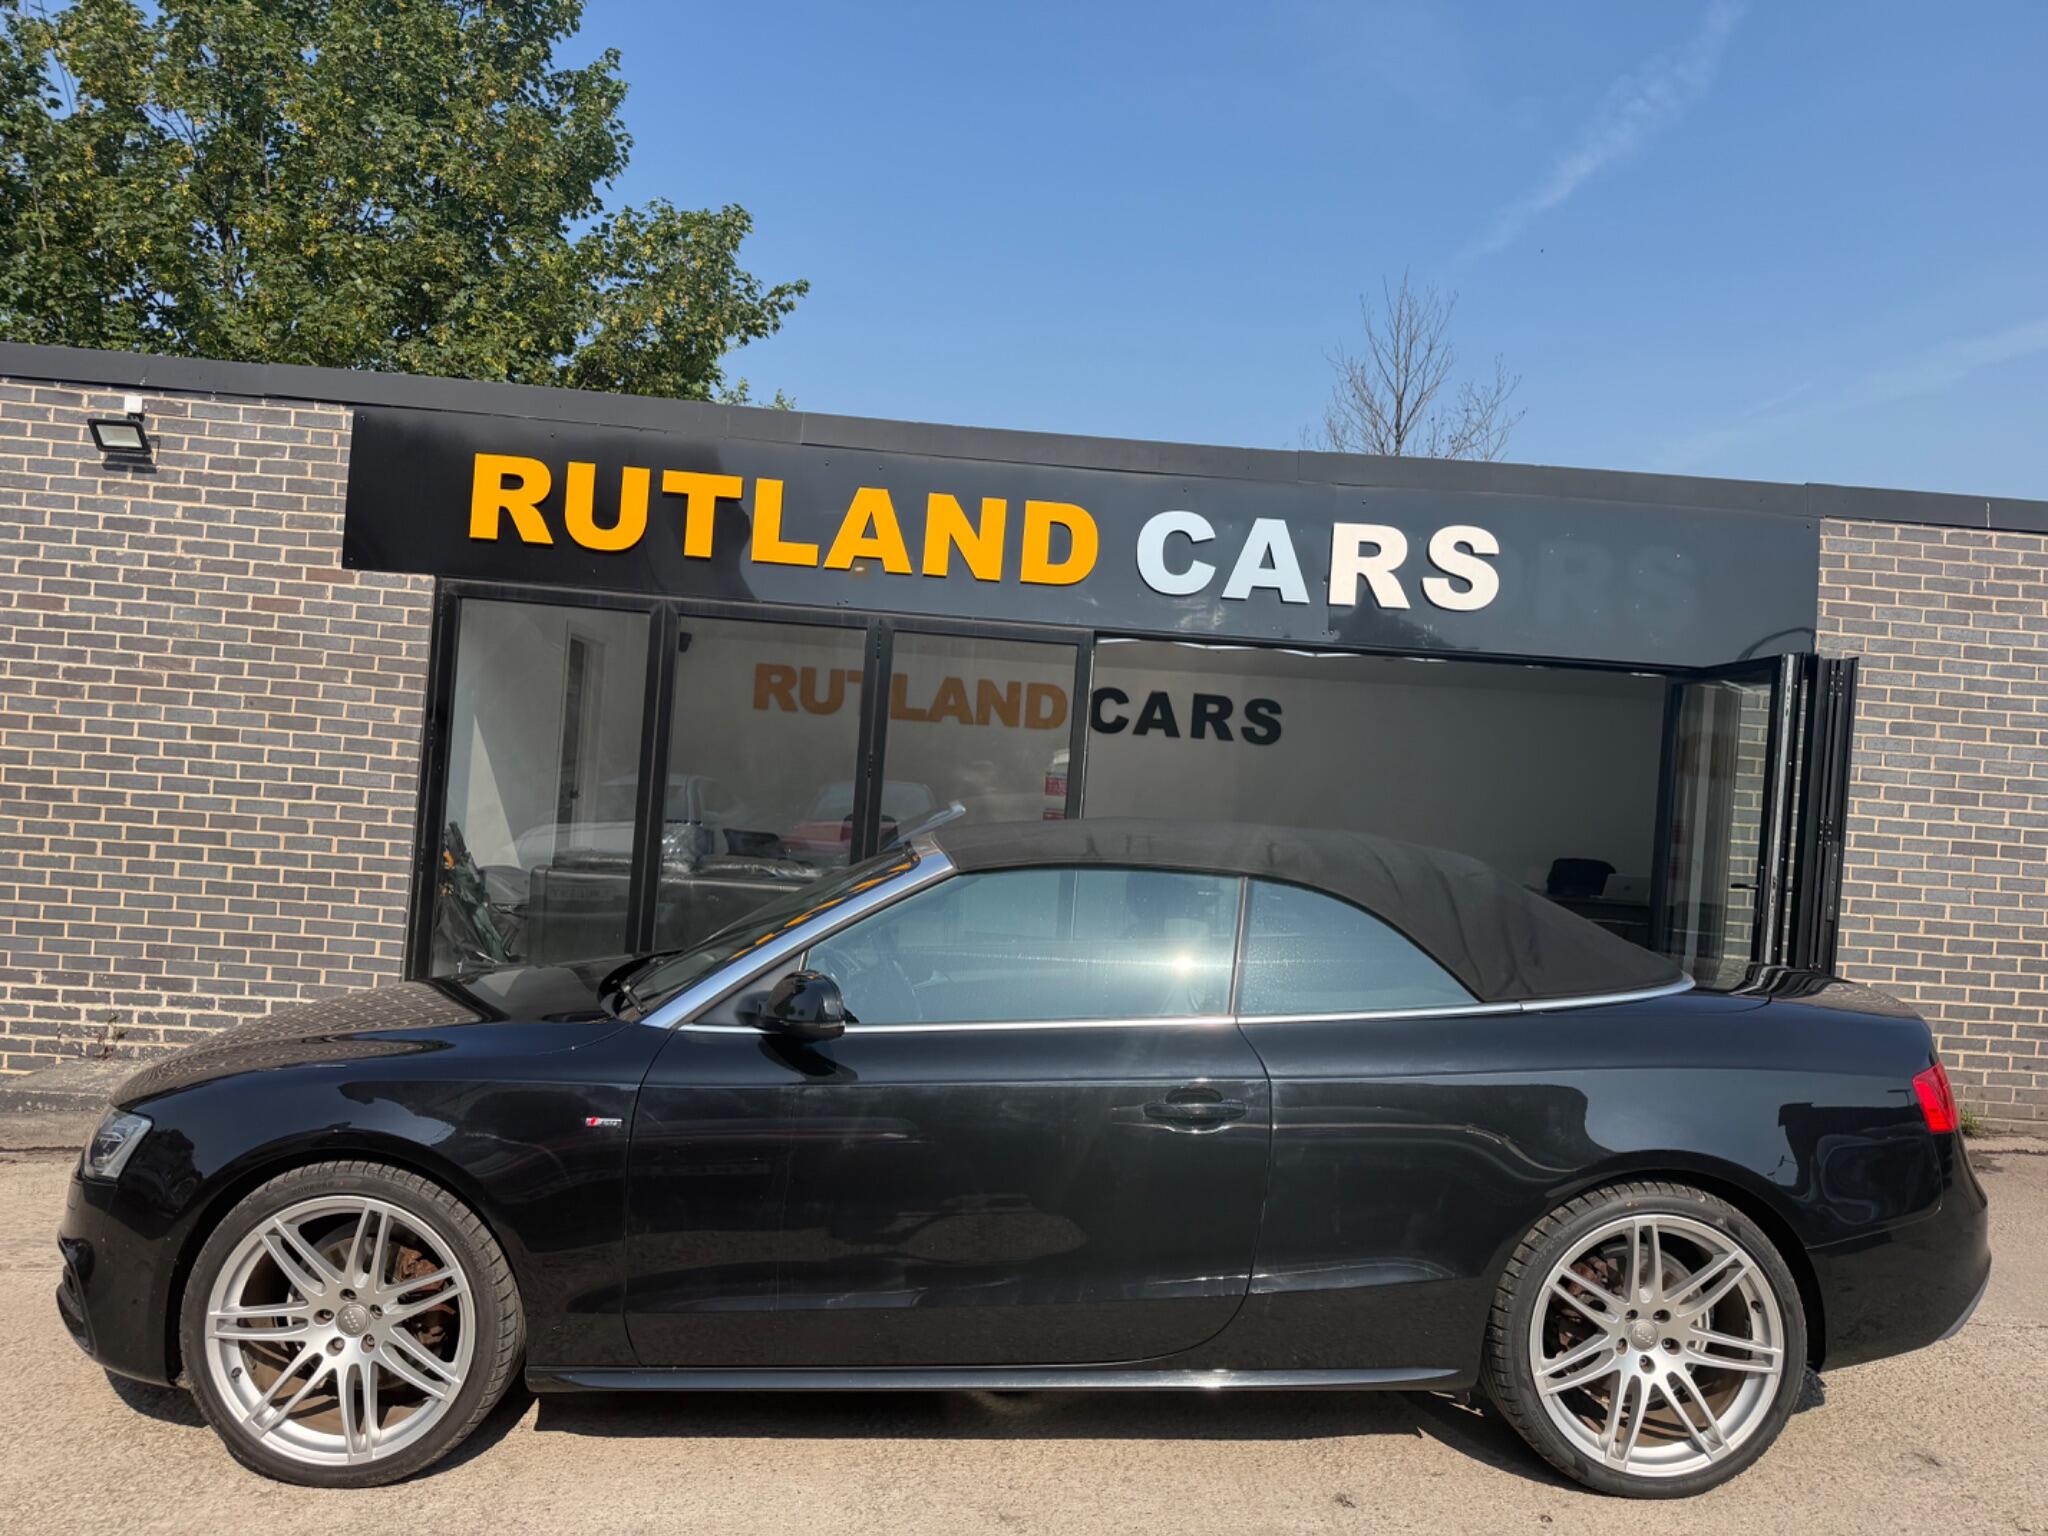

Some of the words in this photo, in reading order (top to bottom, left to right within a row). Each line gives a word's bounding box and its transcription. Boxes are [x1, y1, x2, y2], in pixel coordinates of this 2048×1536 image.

[469, 453, 1099, 585] RUTLAND
[1136, 510, 1501, 611] CARS
[753, 662, 1068, 730] RULAND
[1090, 686, 1283, 747] CARS
